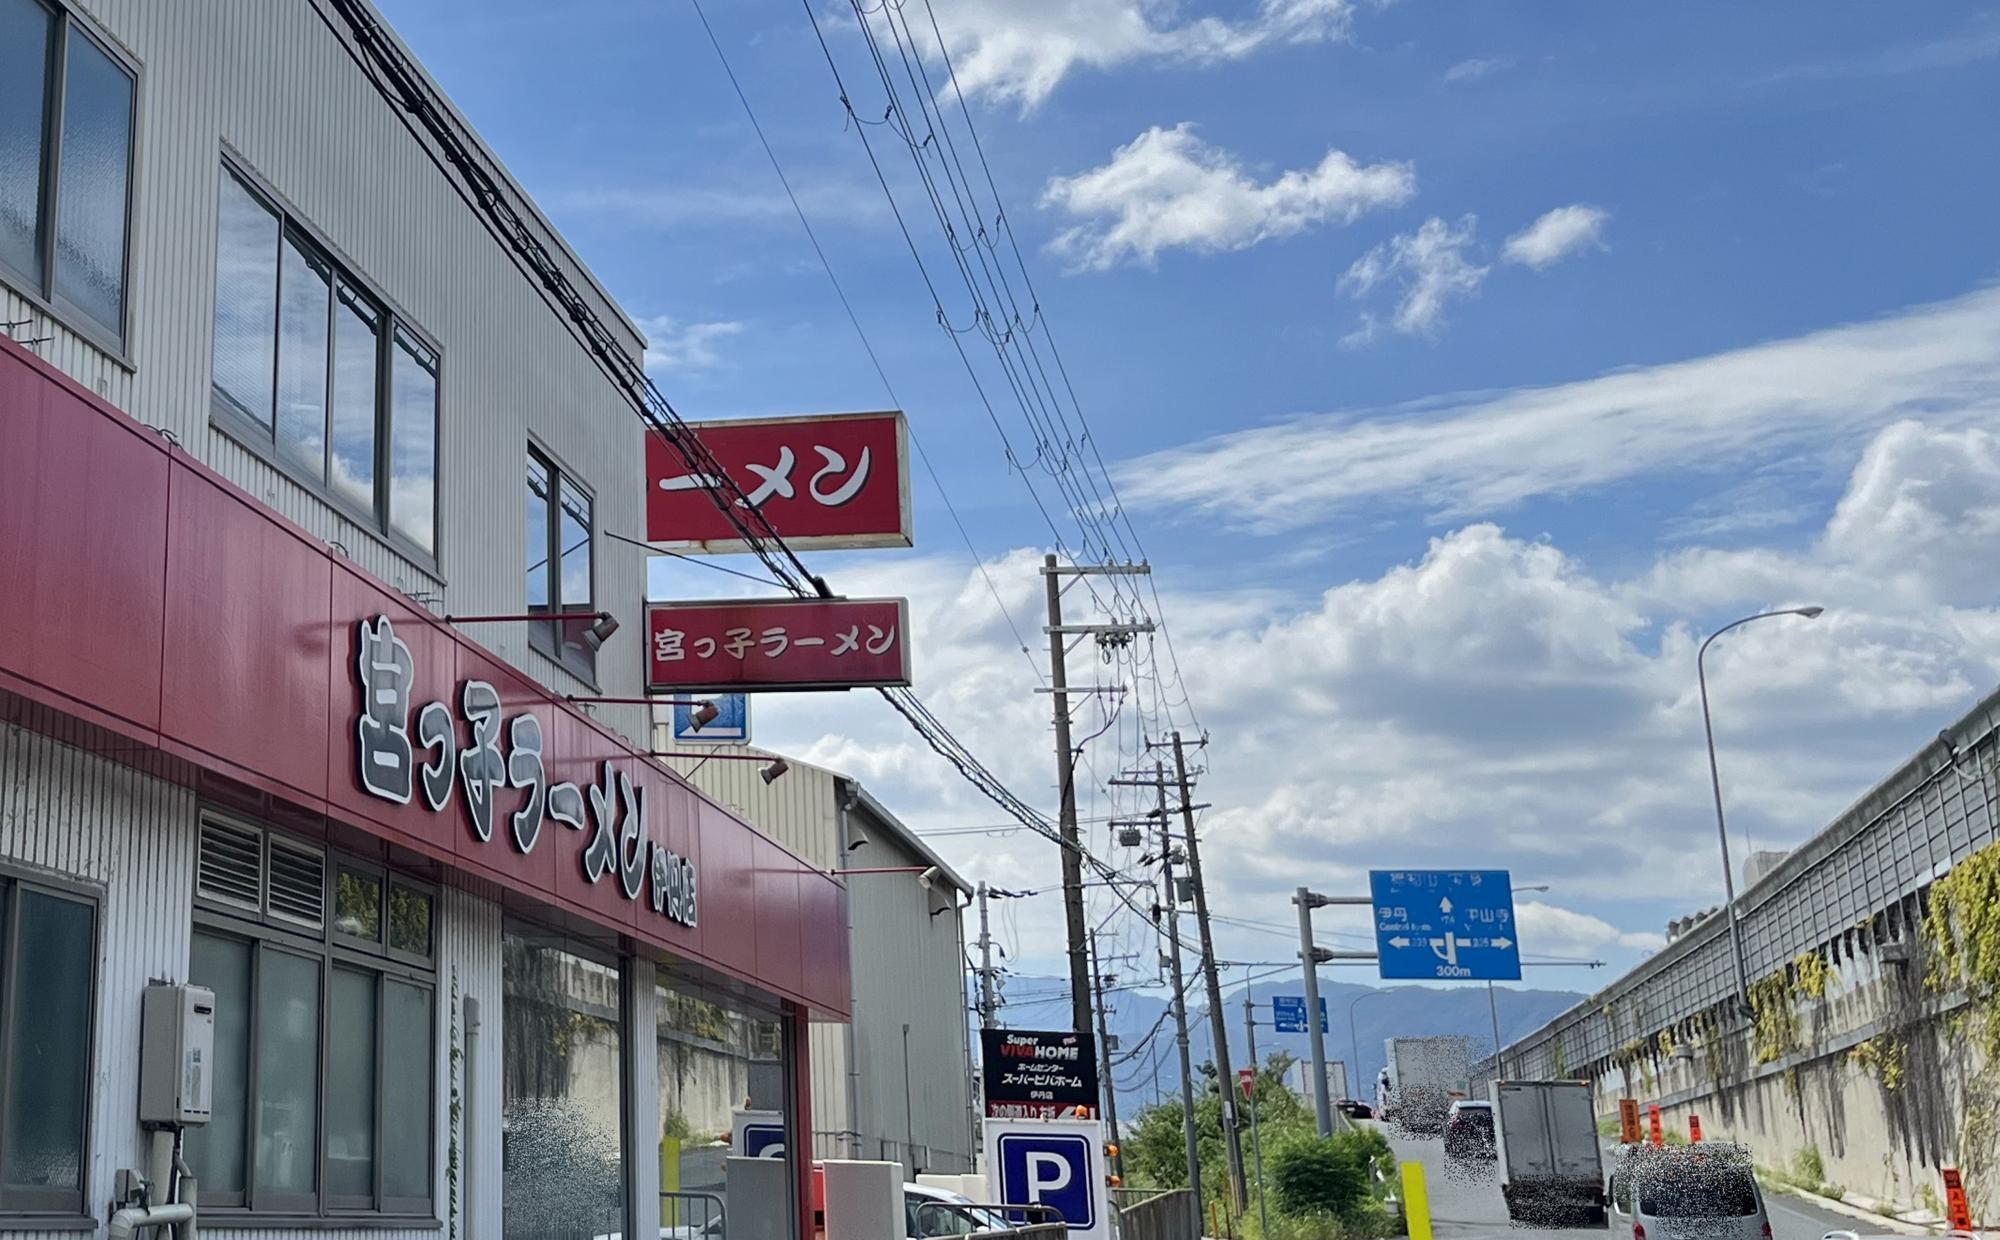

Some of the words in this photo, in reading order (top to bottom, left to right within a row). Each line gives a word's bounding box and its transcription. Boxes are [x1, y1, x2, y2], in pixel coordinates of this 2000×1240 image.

[654, 622, 896, 662] 宮っ子ラーメン
[359, 614, 647, 900] 宮っ子ラーメン
[1436, 965, 1472, 977] 300m
[1006, 1033, 1039, 1046] Super
[1017, 1063, 1065, 1073] ホームセンター
[1026, 1151, 1072, 1204] P
